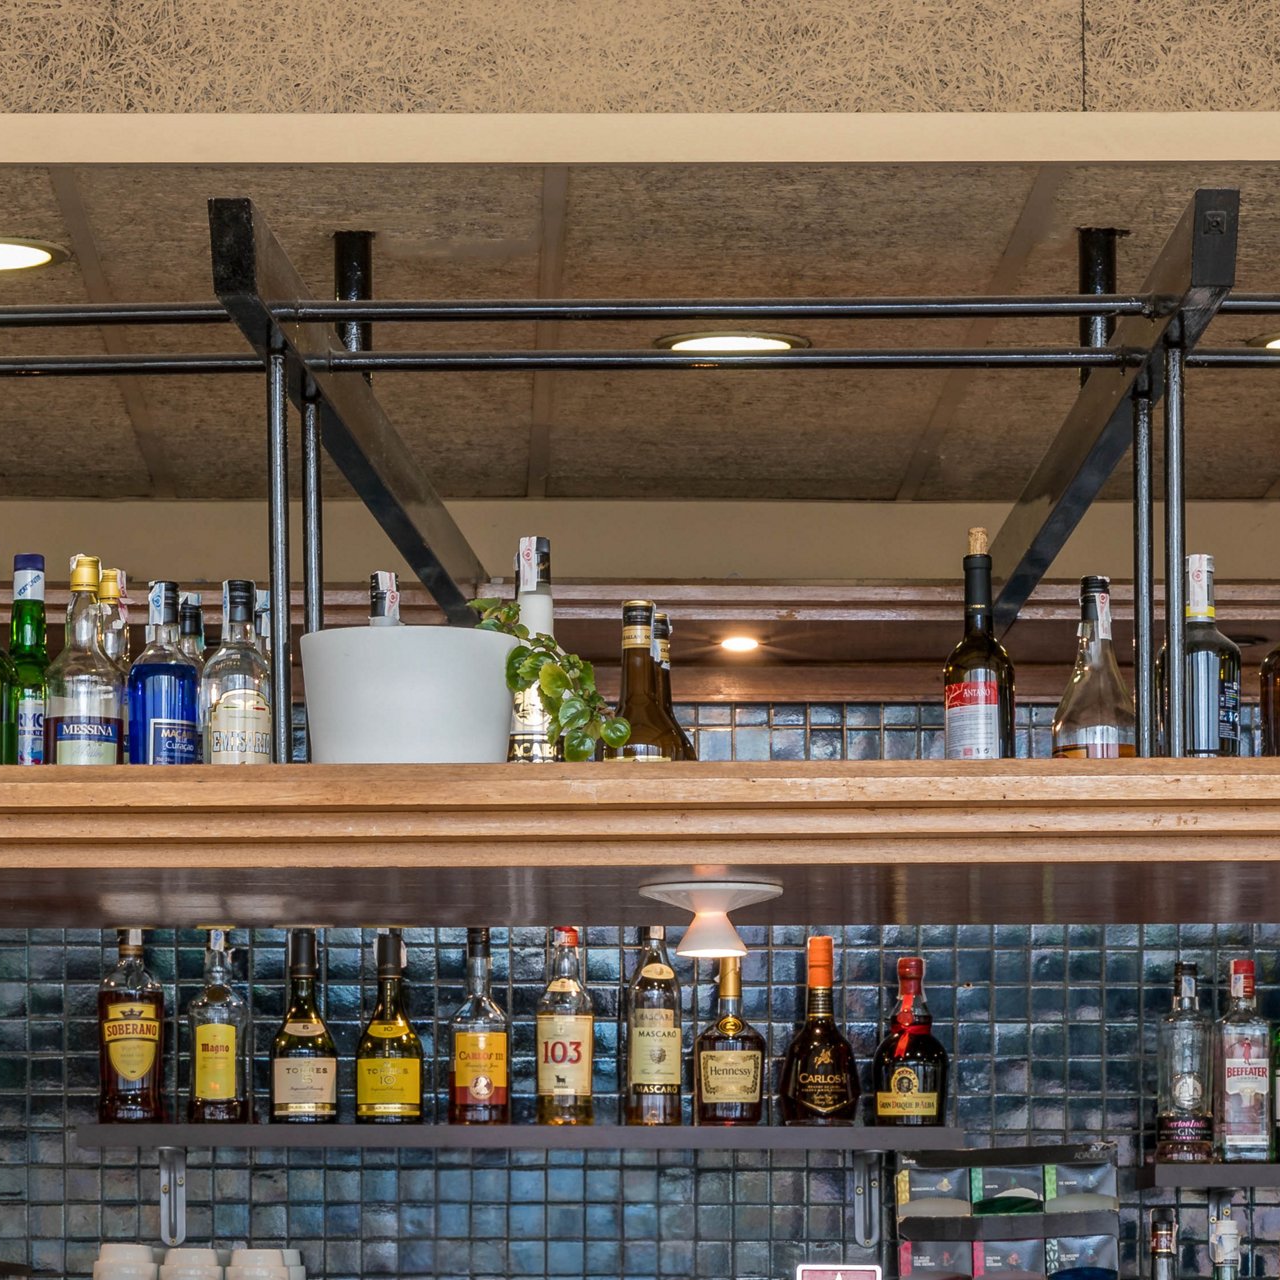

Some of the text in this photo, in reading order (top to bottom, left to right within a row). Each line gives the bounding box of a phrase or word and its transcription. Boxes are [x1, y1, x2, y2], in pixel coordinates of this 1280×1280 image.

[62, 724, 113, 736] MESSINA
[106, 1023, 158, 1037] SOBERANO
[638, 1030, 677, 1038] MASCARÓ
[201, 1043, 230, 1054] Magno
[543, 1040, 583, 1064] 103
[709, 1066, 752, 1077] Hennessy
[1227, 1067, 1268, 1078] BEEFEATER
[799, 1073, 841, 1084] CARLOS
[635, 1084, 678, 1094] MASCARÓ
[1177, 1128, 1196, 1136] GIN
